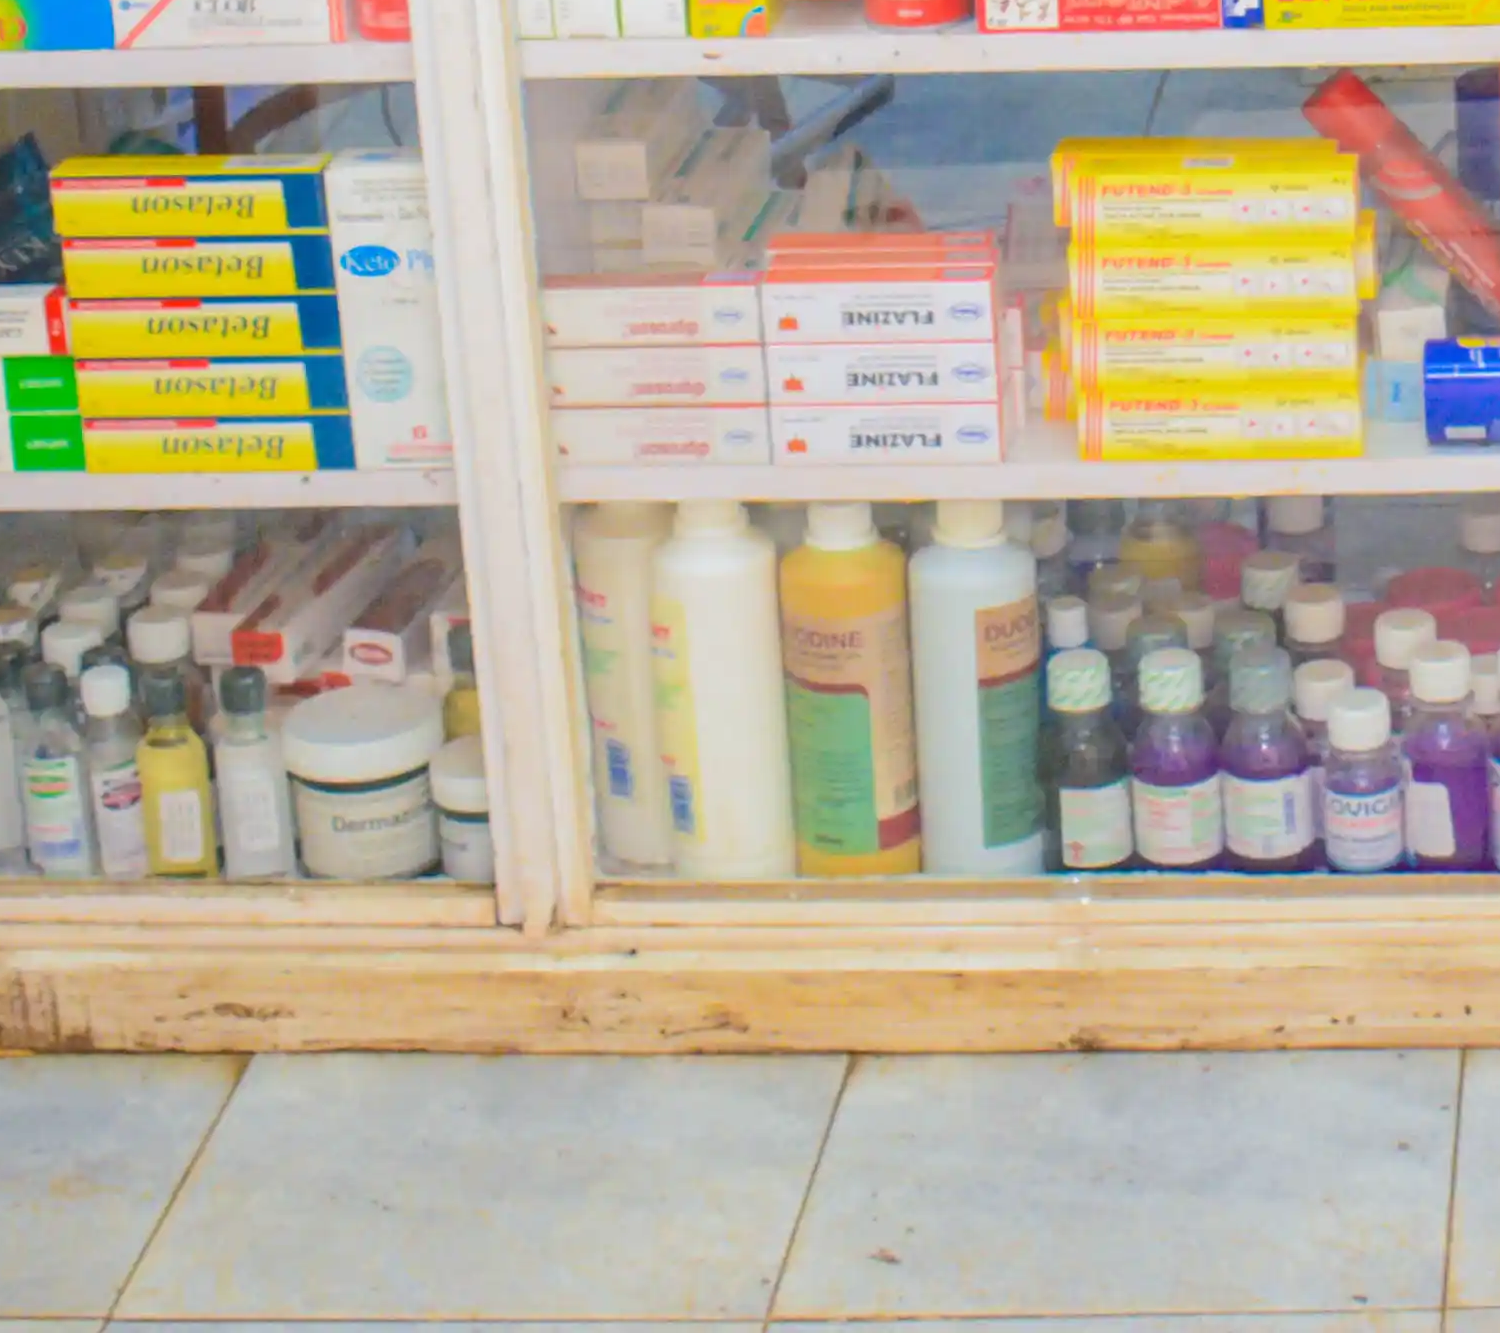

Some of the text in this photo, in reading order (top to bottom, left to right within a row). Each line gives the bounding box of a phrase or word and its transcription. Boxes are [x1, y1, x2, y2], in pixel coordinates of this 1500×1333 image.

[131, 190, 258, 223] Betason
[140, 250, 267, 282] Betason
[146, 310, 272, 341] Betason
[841, 310, 934, 329] FLAZINE
[154, 370, 280, 402] Betason
[845, 371, 939, 389] FLAZINE
[160, 428, 287, 461] Betason
[849, 432, 943, 452] FLAZINE
